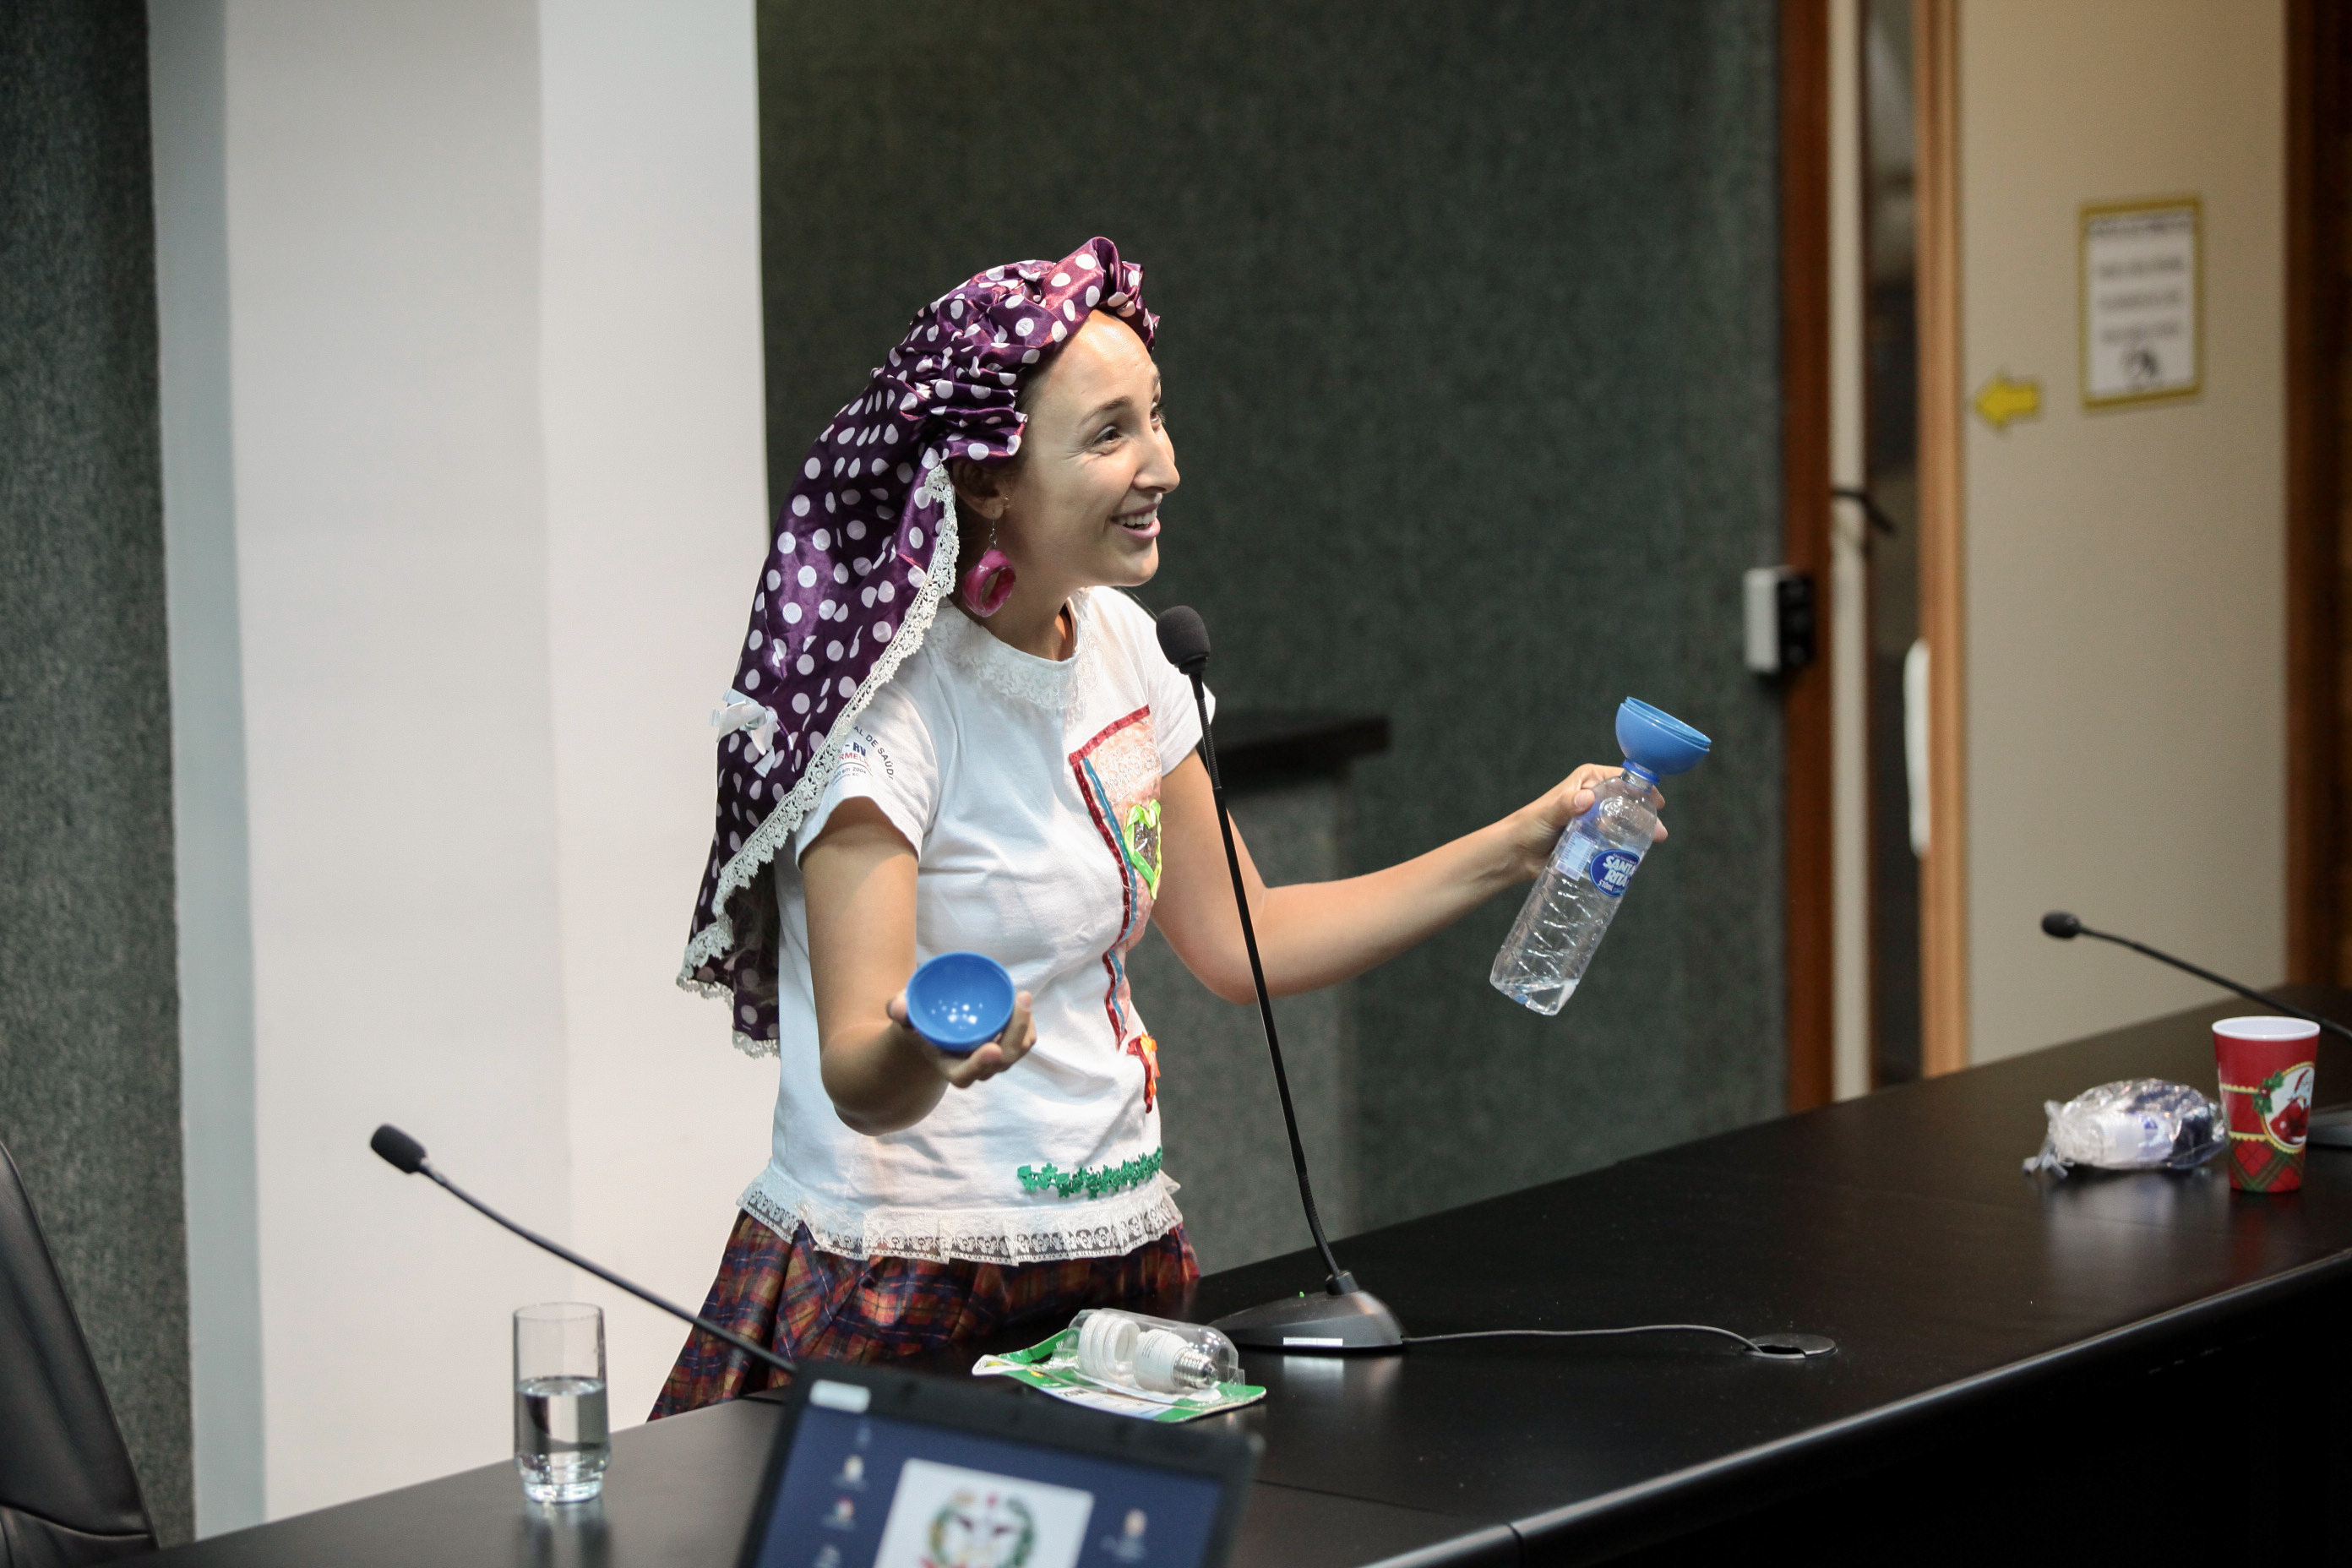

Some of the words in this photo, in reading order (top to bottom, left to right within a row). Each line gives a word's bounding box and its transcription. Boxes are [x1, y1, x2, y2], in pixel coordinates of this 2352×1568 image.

[866, 734, 879, 748] DE
[1603, 855, 1636, 876] SANTA
[1604, 868, 1628, 887] RITA
